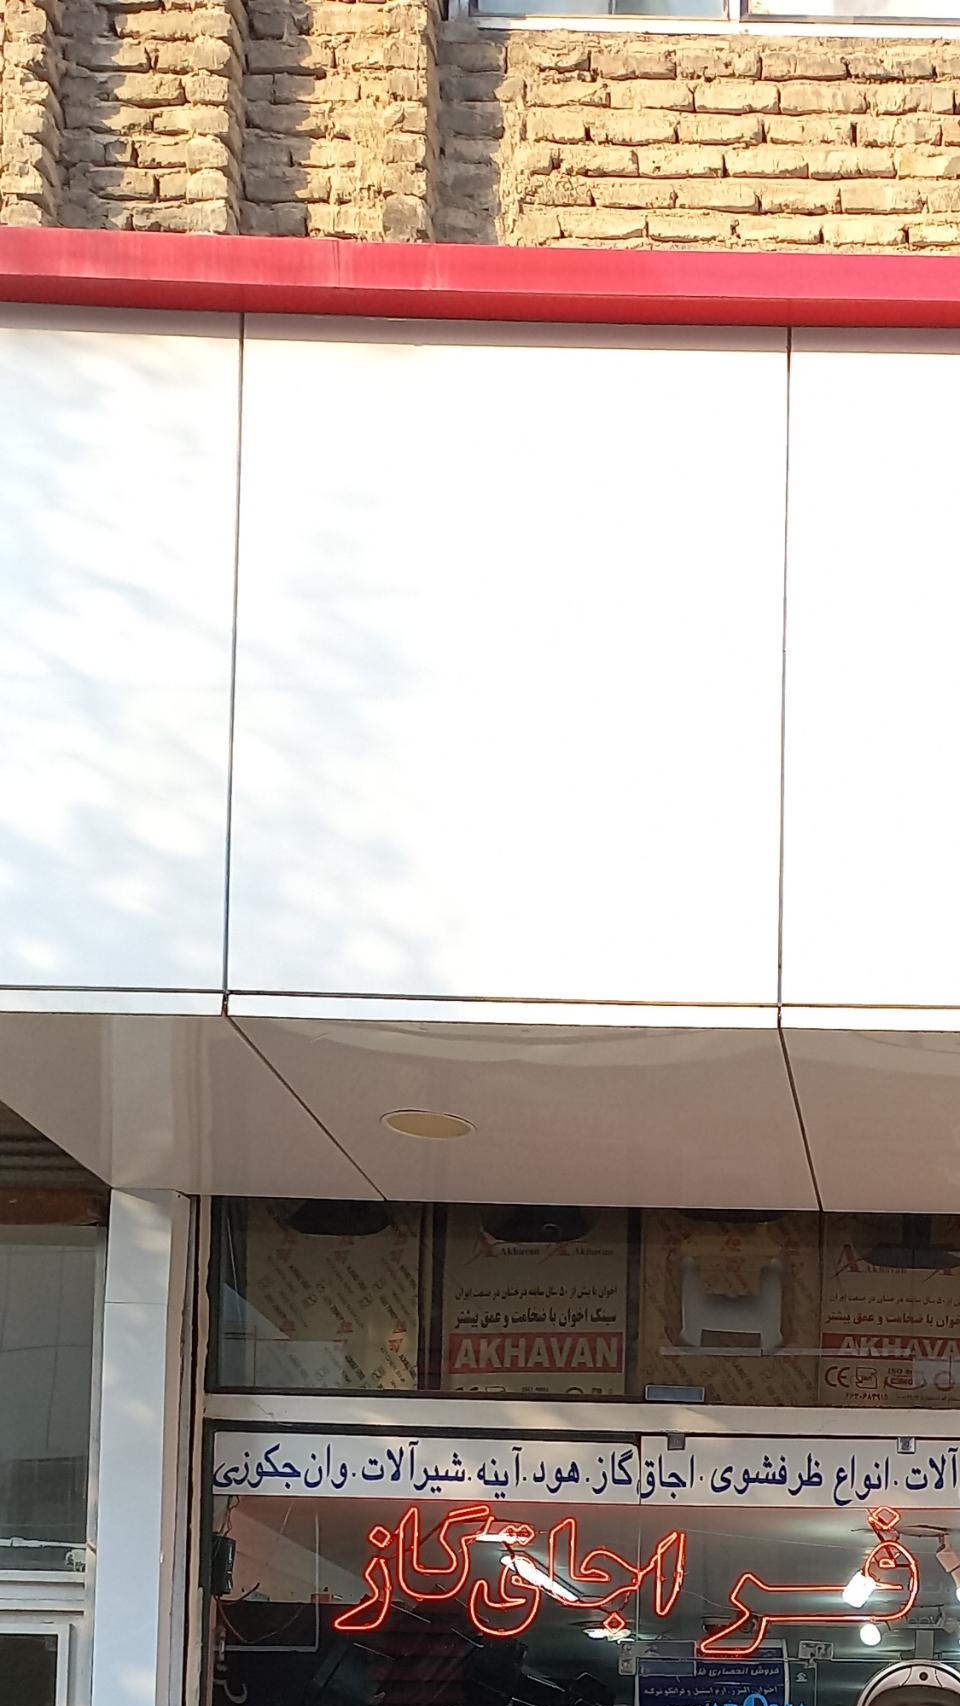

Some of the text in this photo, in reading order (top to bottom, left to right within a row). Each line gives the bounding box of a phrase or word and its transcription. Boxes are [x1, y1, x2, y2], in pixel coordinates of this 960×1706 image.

[455, 1309, 478, 1329] بیشتر
[504, 1314, 509, 1328] و
[511, 1307, 547, 1323] ضخامت
[549, 1307, 557, 1327] با
[558, 1308, 588, 1328] اخوان
[590, 1308, 616, 1325] سینک
[454, 1337, 618, 1369] AKHAVAN
[212, 1443, 301, 1489] جکوزی
[304, 1443, 348, 1489] وان
[476, 1446, 522, 1499] آینه
[532, 1461, 580, 1495] هود
[592, 1449, 635, 1496] گاز
[640, 1453, 694, 1500] اجاق
[833, 1455, 890, 1505] انواع
[333, 1505, 494, 1632] گاز
[470, 1517, 688, 1636] اجاق
[699, 1505, 920, 1658] فر
